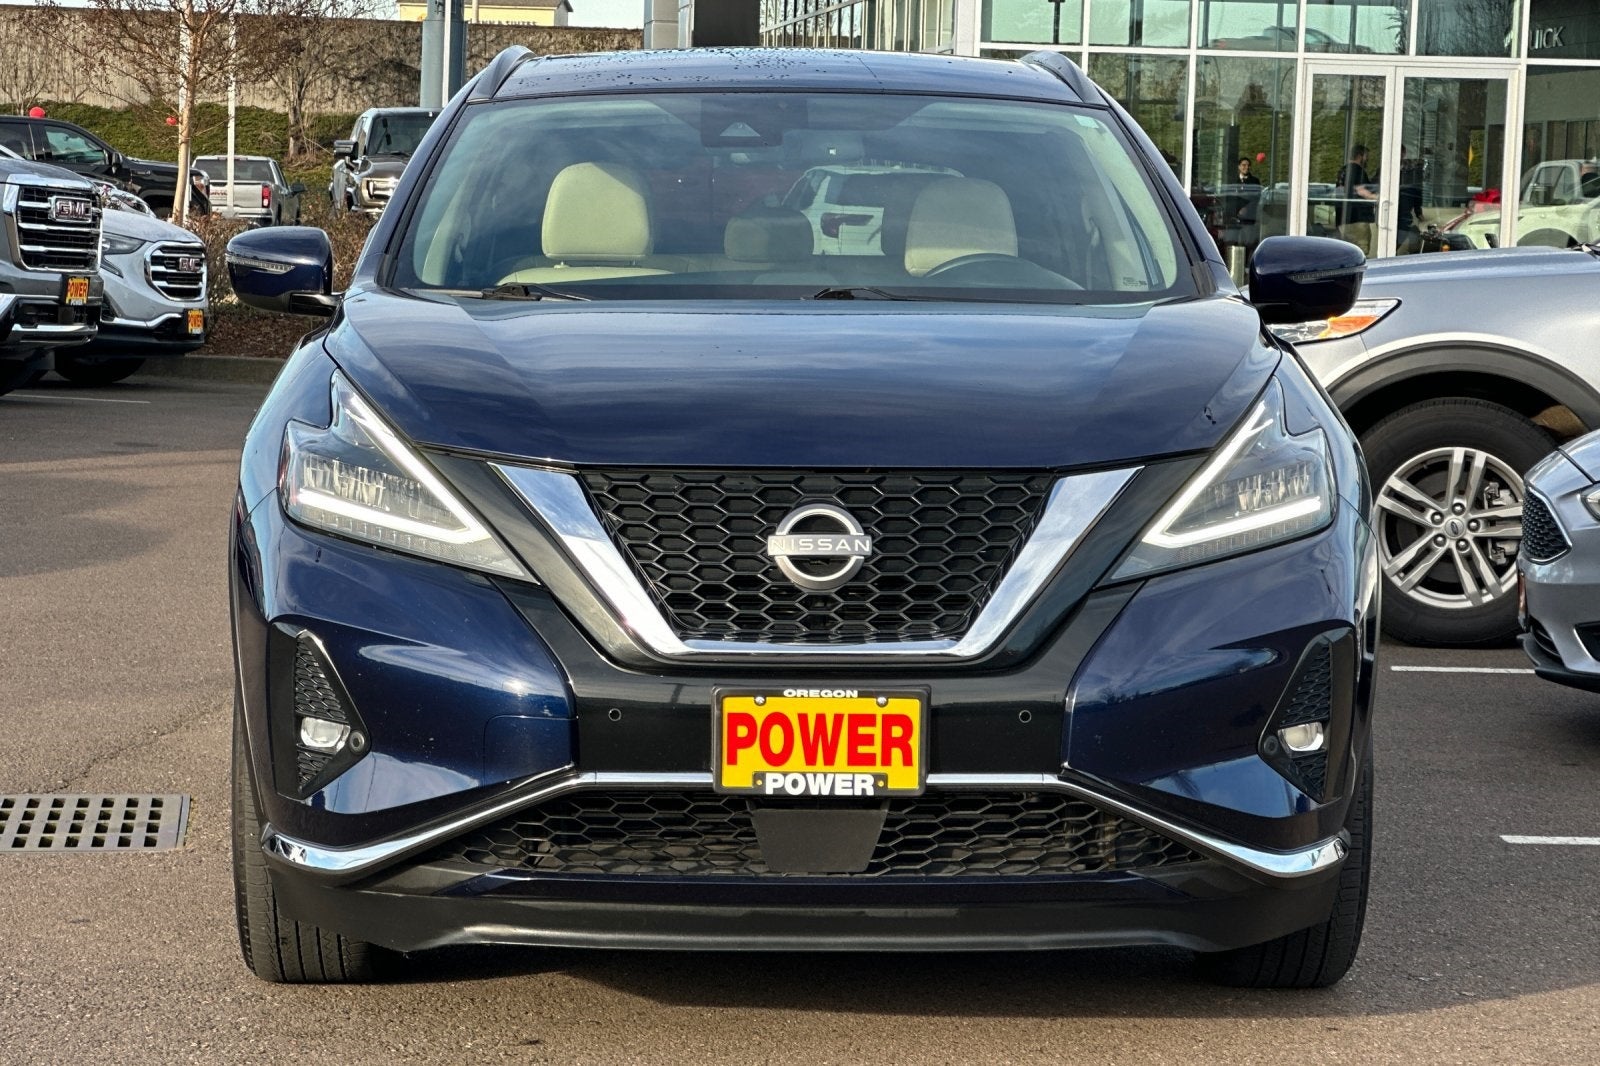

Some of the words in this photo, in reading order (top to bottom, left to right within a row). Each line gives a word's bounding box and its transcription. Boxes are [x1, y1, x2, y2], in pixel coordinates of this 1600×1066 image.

[1529, 26, 1564, 50] UICK
[56, 200, 92, 219] GMC
[771, 538, 870, 552] NISSAN
[783, 688, 859, 698] OREGON
[726, 711, 914, 767] POWER
[765, 772, 875, 796] POWER
